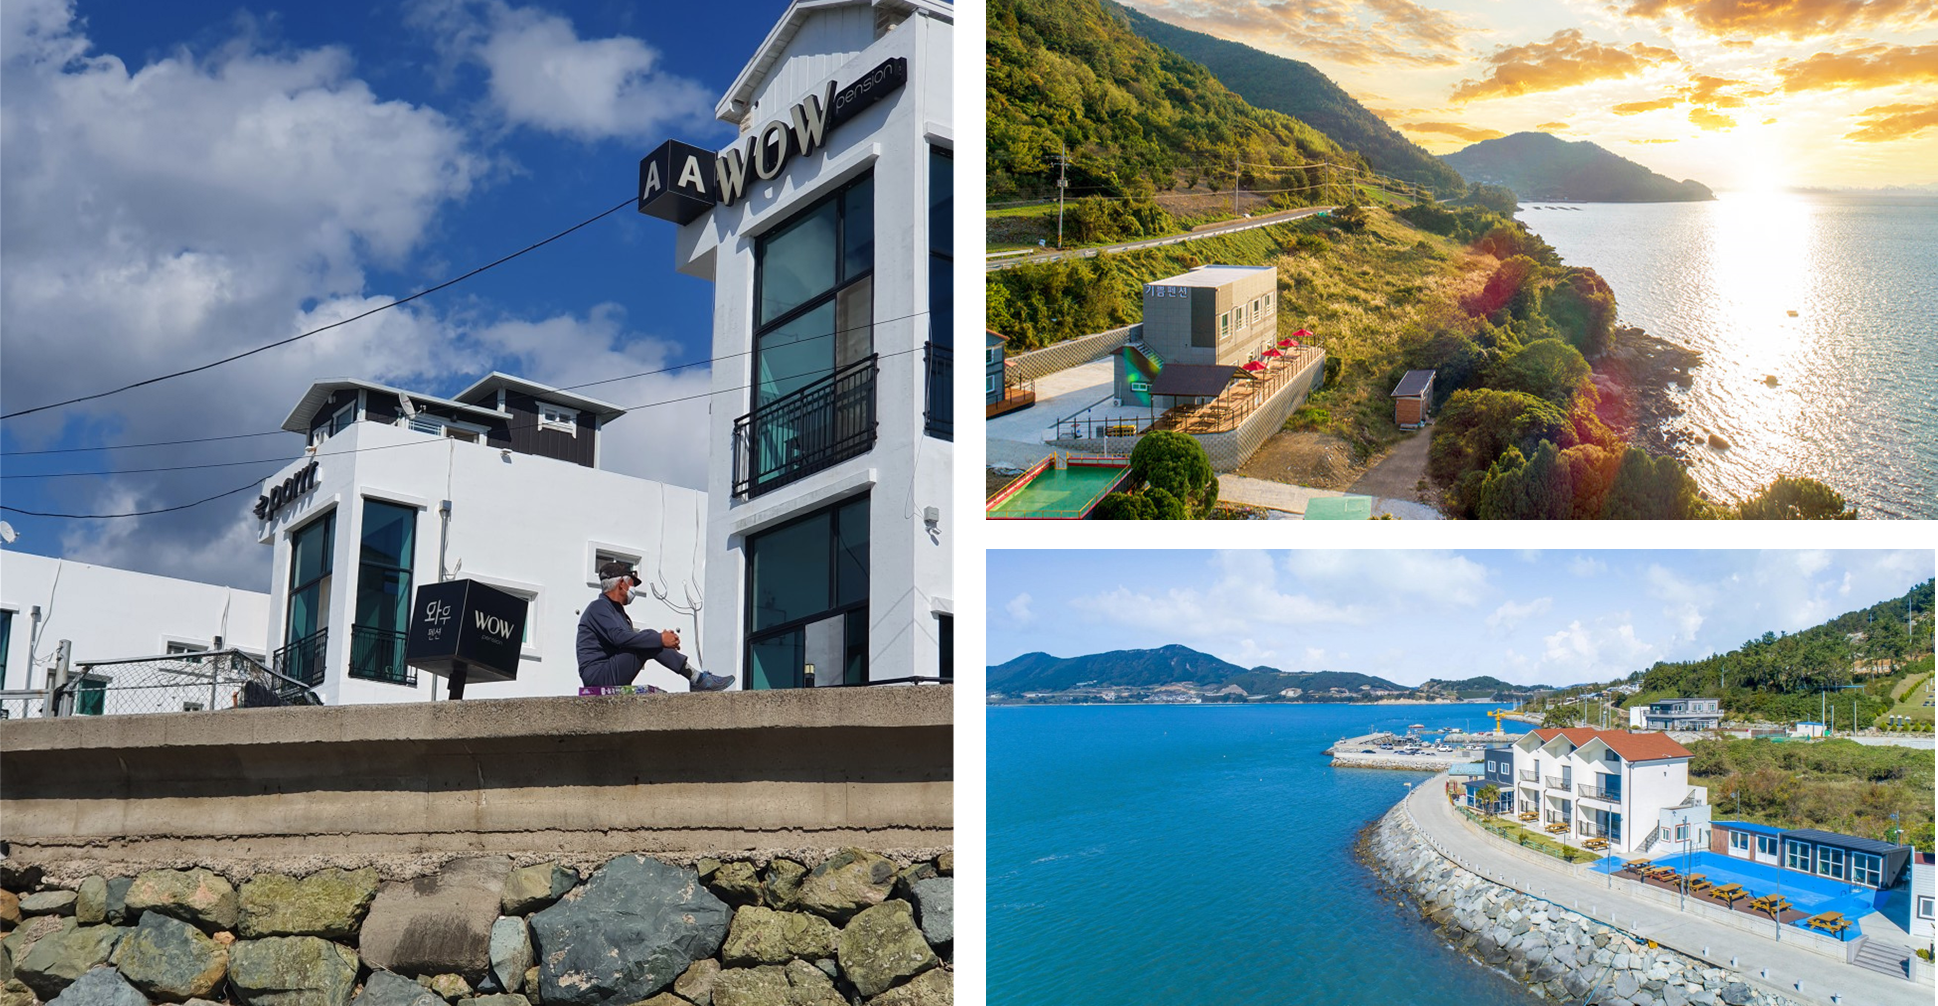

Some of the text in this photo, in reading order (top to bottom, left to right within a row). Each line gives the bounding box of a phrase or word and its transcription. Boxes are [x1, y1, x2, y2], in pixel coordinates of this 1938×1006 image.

[677, 63, 893, 207] A WOW pension
[643, 160, 662, 200] A
[424, 599, 452, 626] 와우
[474, 609, 515, 640] WOW
[427, 627, 442, 641] 펜션
